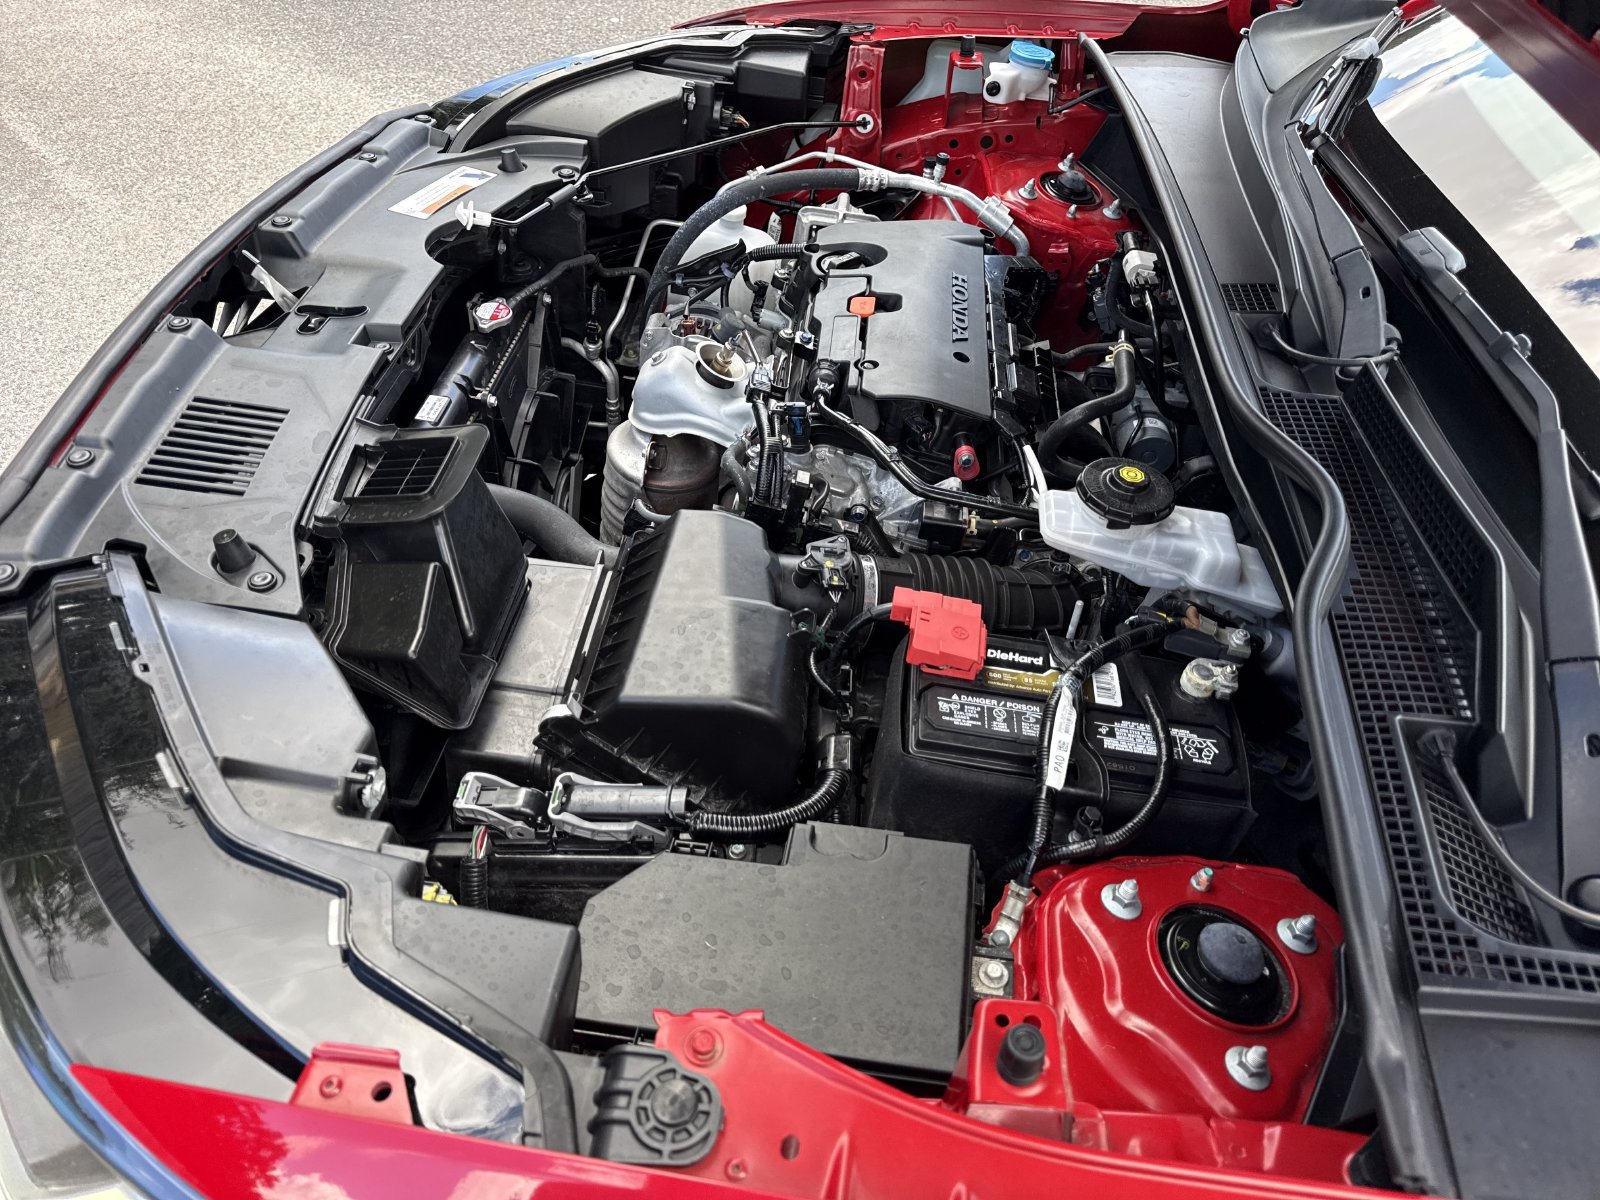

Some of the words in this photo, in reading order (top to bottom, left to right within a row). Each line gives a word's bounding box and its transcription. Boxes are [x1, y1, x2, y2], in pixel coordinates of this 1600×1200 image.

[952, 271, 969, 344] HONDA
[986, 648, 1044, 666] DieHard
[961, 695, 998, 706] DANGER
[1006, 702, 1040, 712] POISON
